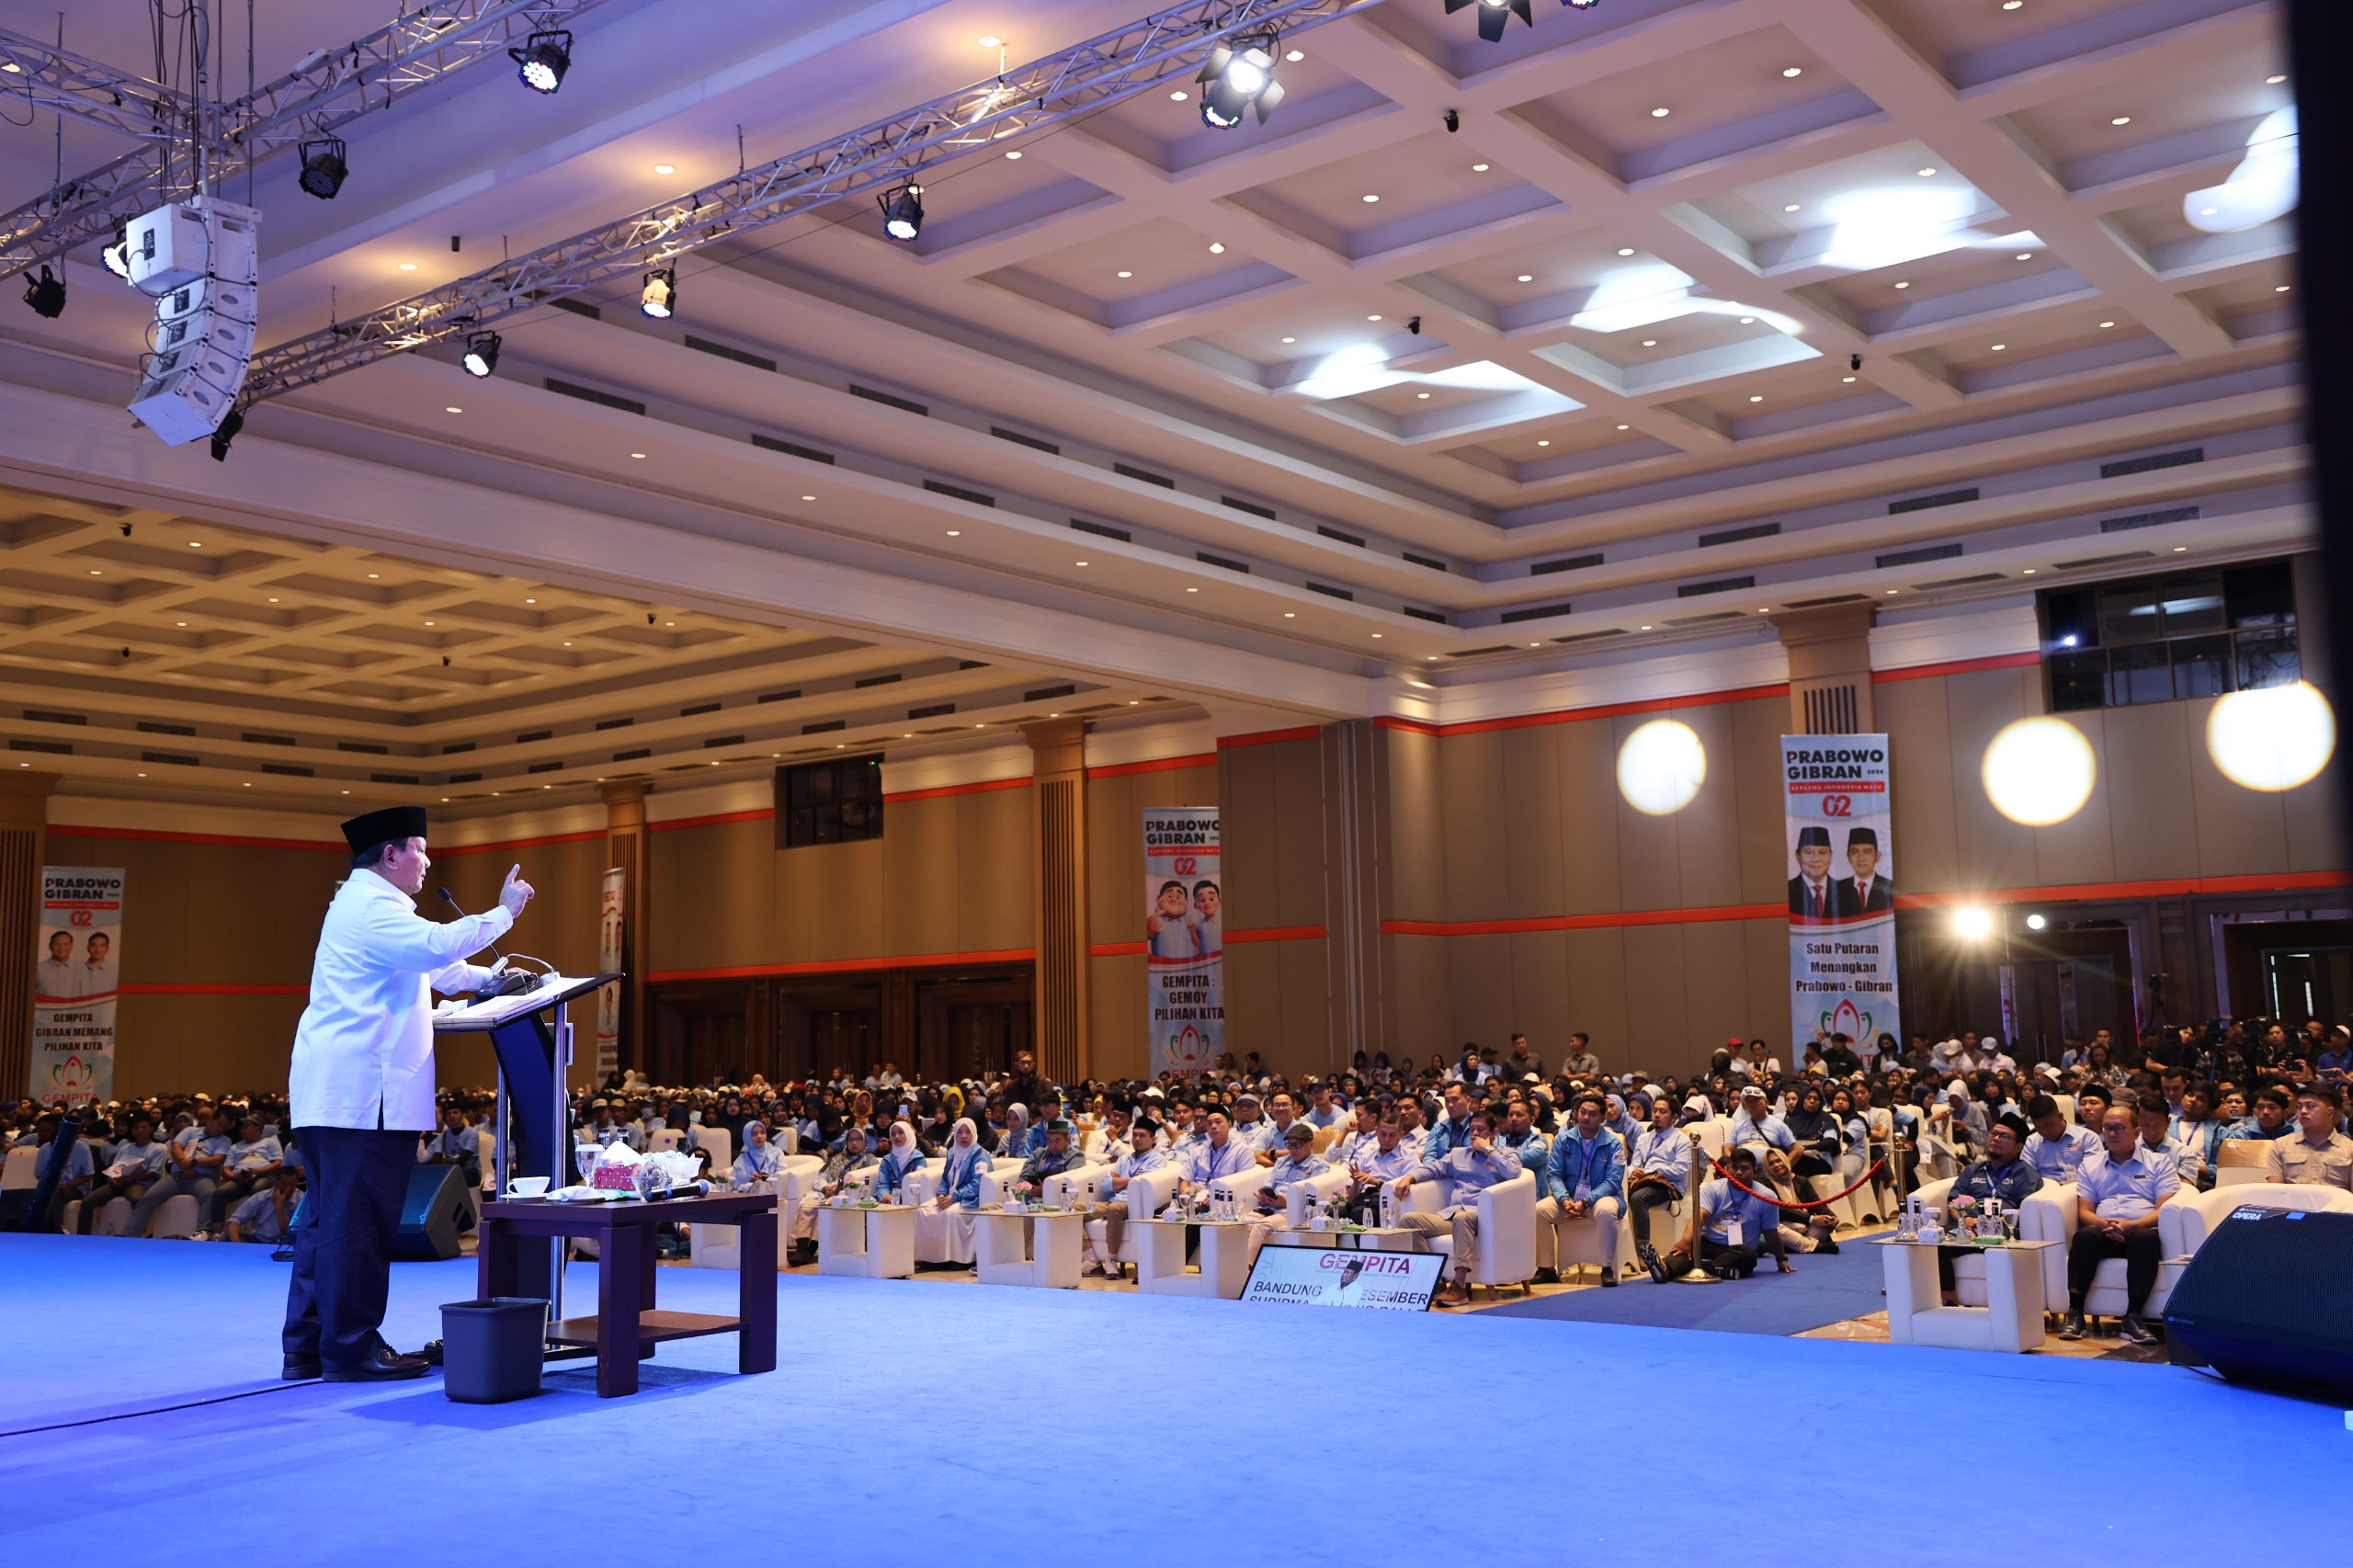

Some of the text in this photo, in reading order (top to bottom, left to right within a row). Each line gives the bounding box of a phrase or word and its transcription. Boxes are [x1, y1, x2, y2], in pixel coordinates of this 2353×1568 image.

[1786, 749, 1884, 764] PRABOWO
[1788, 766, 1862, 779] GIBRAN
[1822, 794, 1852, 817] 02
[1146, 833, 1205, 845] GIBRAN
[1174, 857, 1197, 876] 02
[45, 878, 121, 889] PRABOWO
[44, 889, 104, 899] GIBRAN
[70, 911, 93, 926] 02
[1806, 943, 1880, 955] Satu Putaran
[1810, 961, 1877, 974] Menangkan
[1163, 975, 1210, 988] GEMPITA
[1796, 980, 1846, 992] Prabowo
[1855, 980, 1893, 992] Gibran
[1169, 992, 1208, 1004] GEMOY
[53, 1013, 93, 1022] GEMPITA
[1154, 1007, 1225, 1020] PILIHAN KITA
[35, 1027, 114, 1037] GIBRAN MEMANG
[44, 1041, 103, 1051] PILIHAN KITA
[2232, 1211, 2263, 1221] OPERA
[1254, 1281, 1428, 1305] BANDUNG ESEMBER
